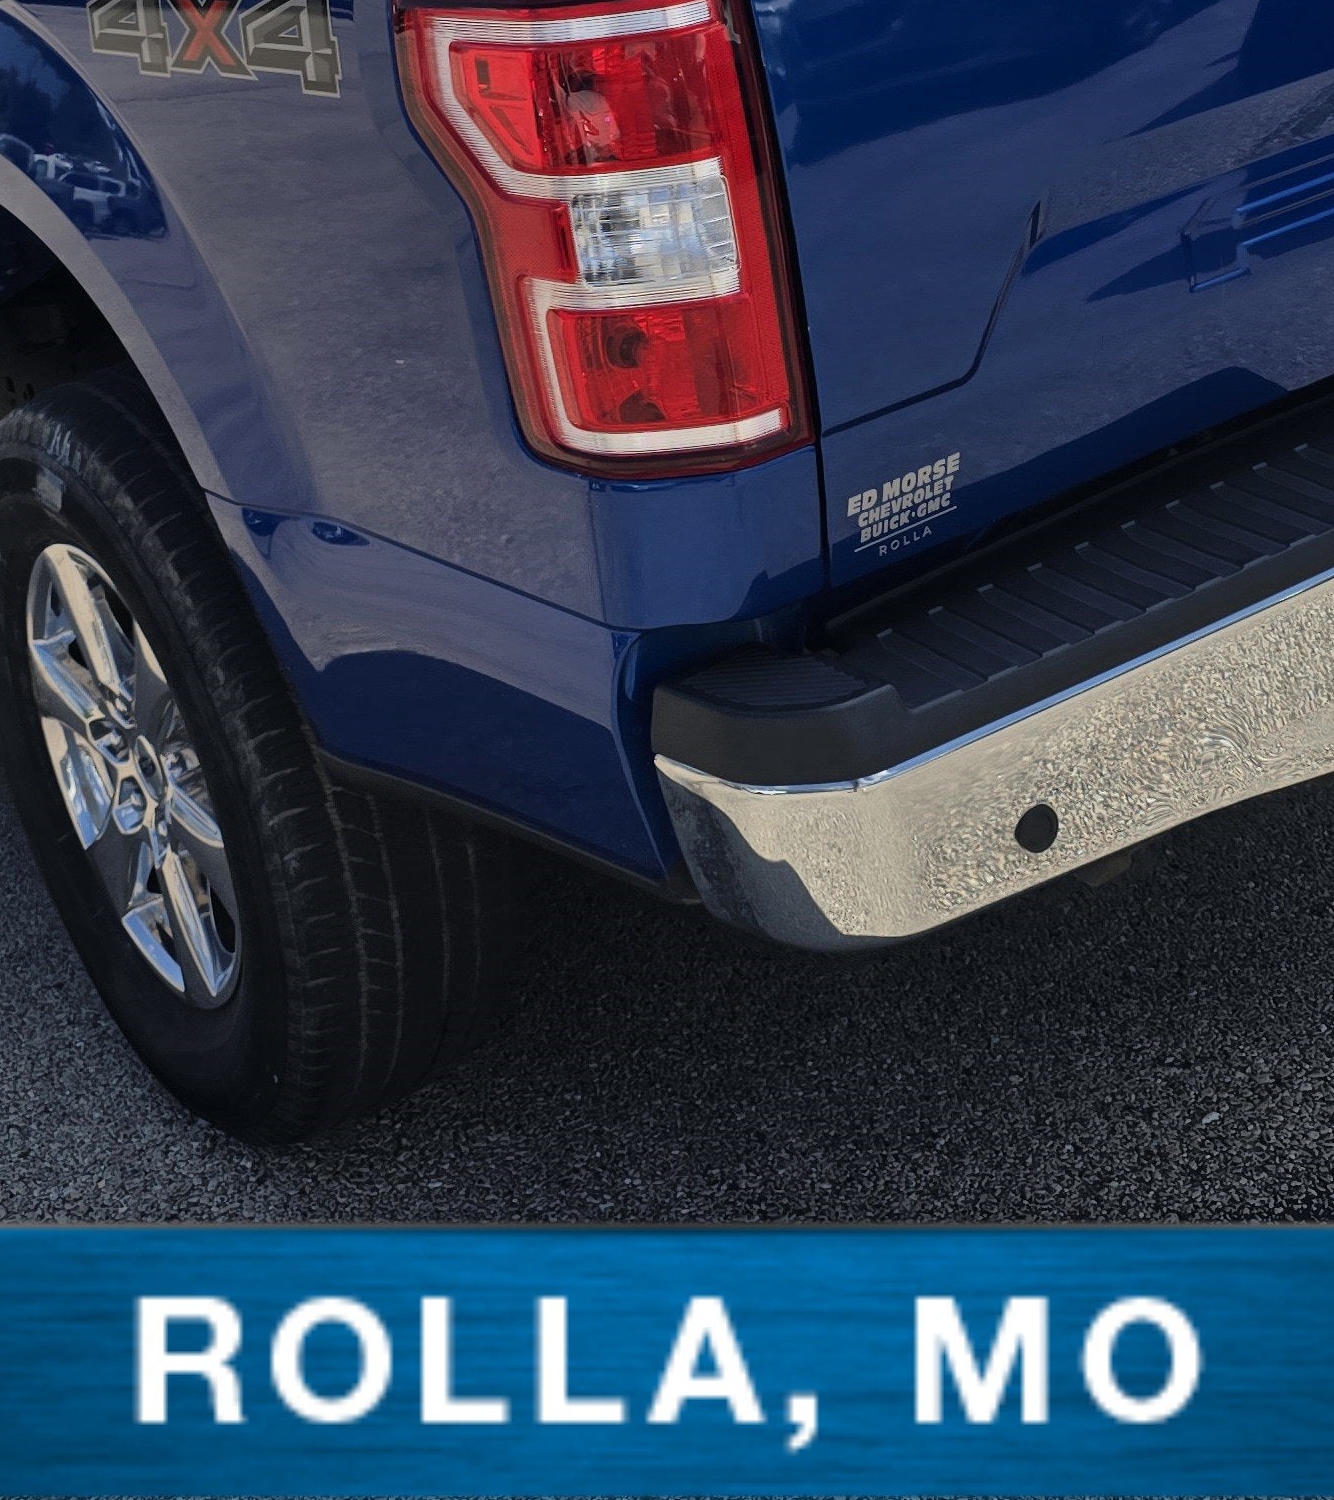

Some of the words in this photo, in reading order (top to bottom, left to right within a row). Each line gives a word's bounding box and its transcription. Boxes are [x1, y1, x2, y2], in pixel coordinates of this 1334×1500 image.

[846, 487, 879, 517] ED
[881, 451, 962, 503] MORSE
[857, 474, 955, 528] CHEVROLET
[877, 525, 933, 557] ROLLA
